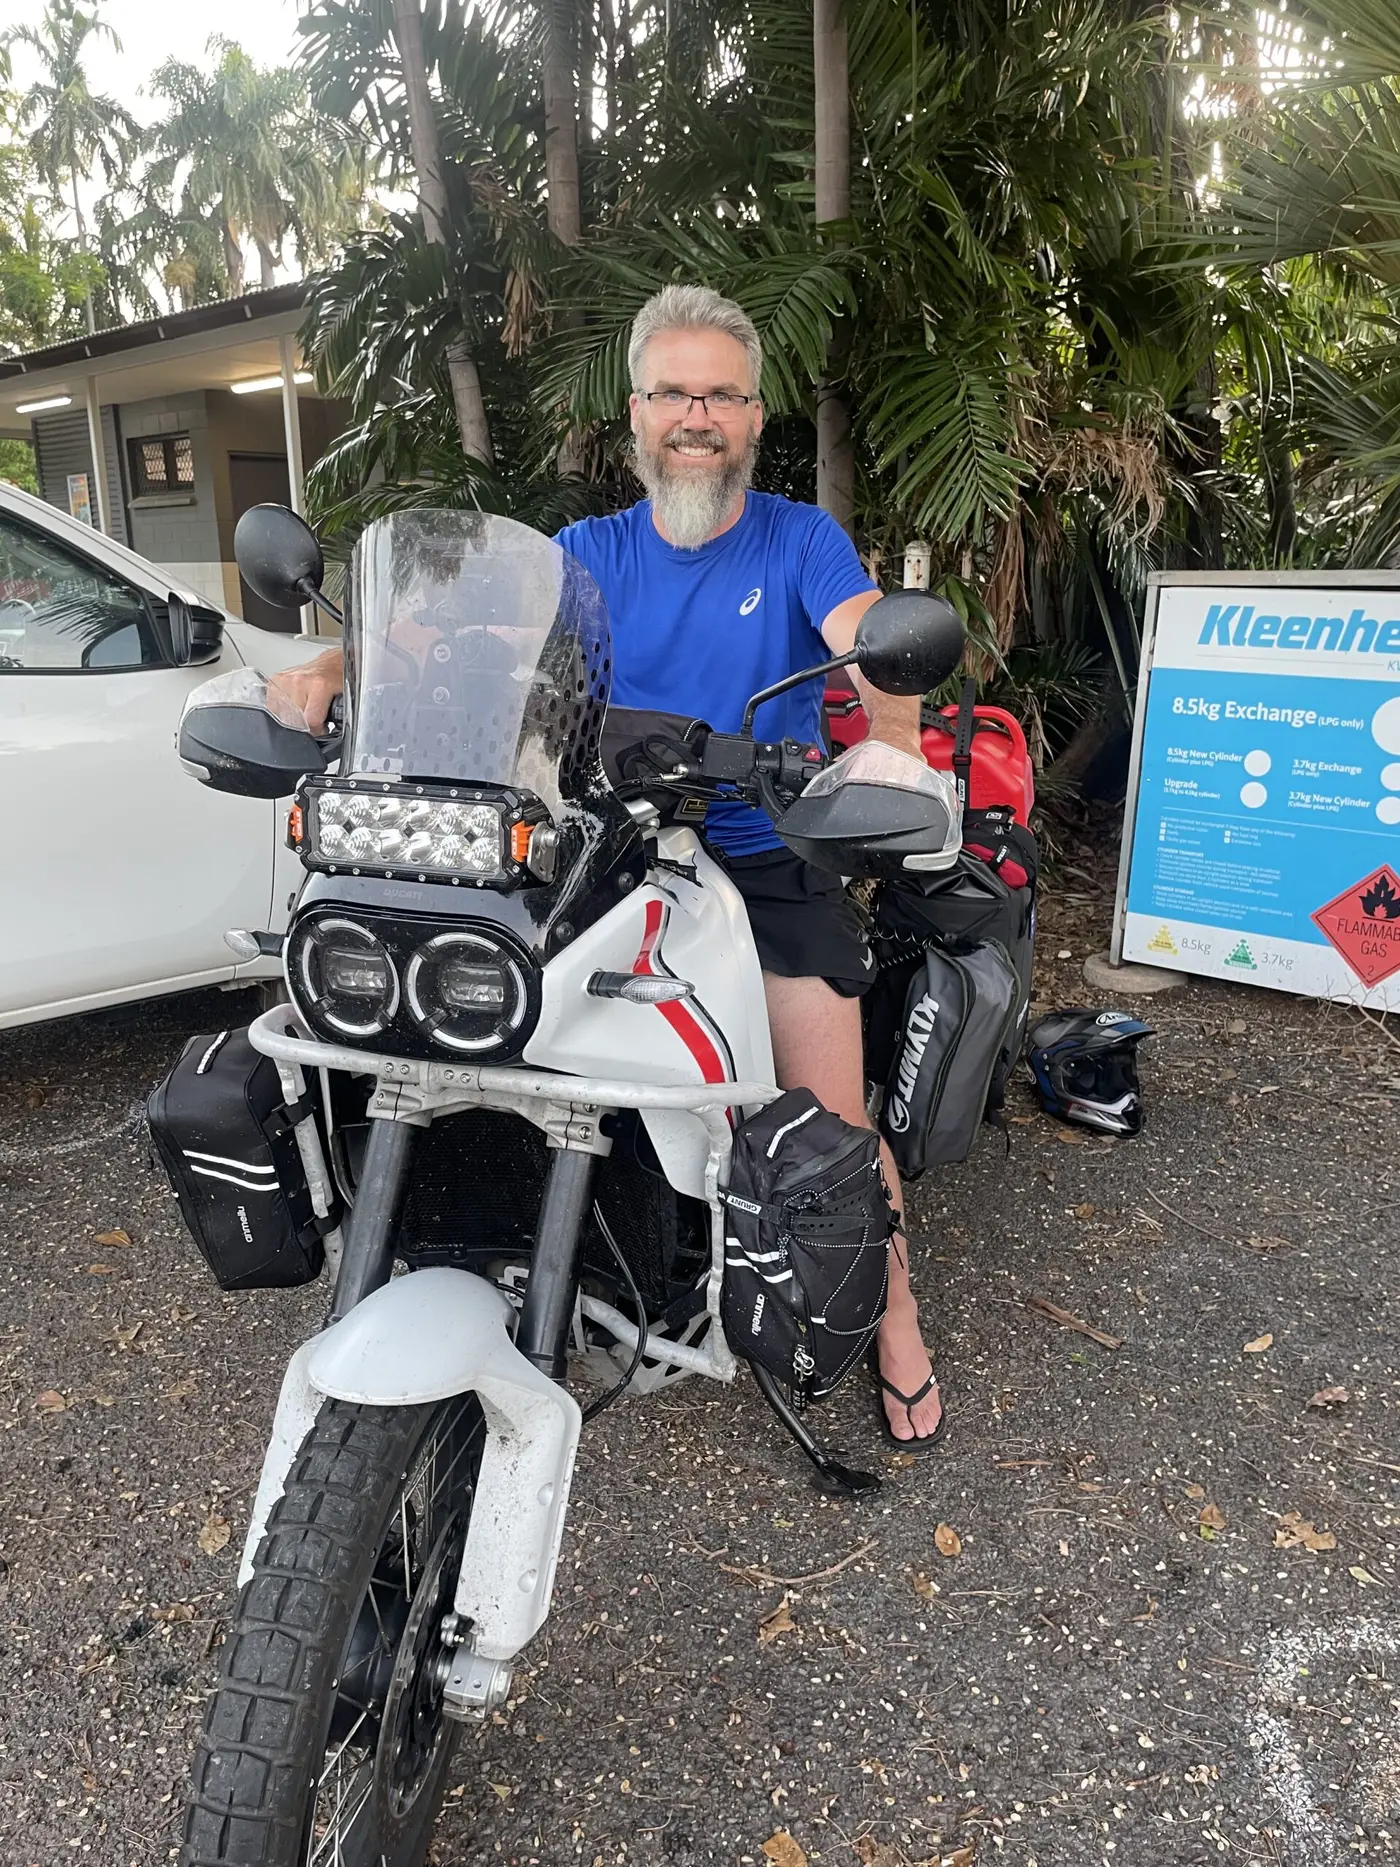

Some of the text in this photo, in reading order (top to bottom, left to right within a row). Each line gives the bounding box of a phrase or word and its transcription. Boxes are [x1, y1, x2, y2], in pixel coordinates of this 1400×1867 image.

[1172, 697, 1364, 731] 8.5kg Exchange (LPG only)
[1167, 746, 1243, 762] 8.5kg New Cylinder
[1292, 759, 1362, 776] 3.7kg Exchange
[1164, 778, 1198, 789] Upgrade
[1288, 790, 1371, 808] 3.7kg New Cylinder
[1181, 937, 1212, 955] 8.5kg
[1360, 940, 1388, 958] GAS
[1261, 952, 1294, 971] 3.7kg
[1367, 964, 1375, 977] 2
[898, 992, 940, 1104] KLYMIT
[730, 1197, 758, 1212] GRUNT
